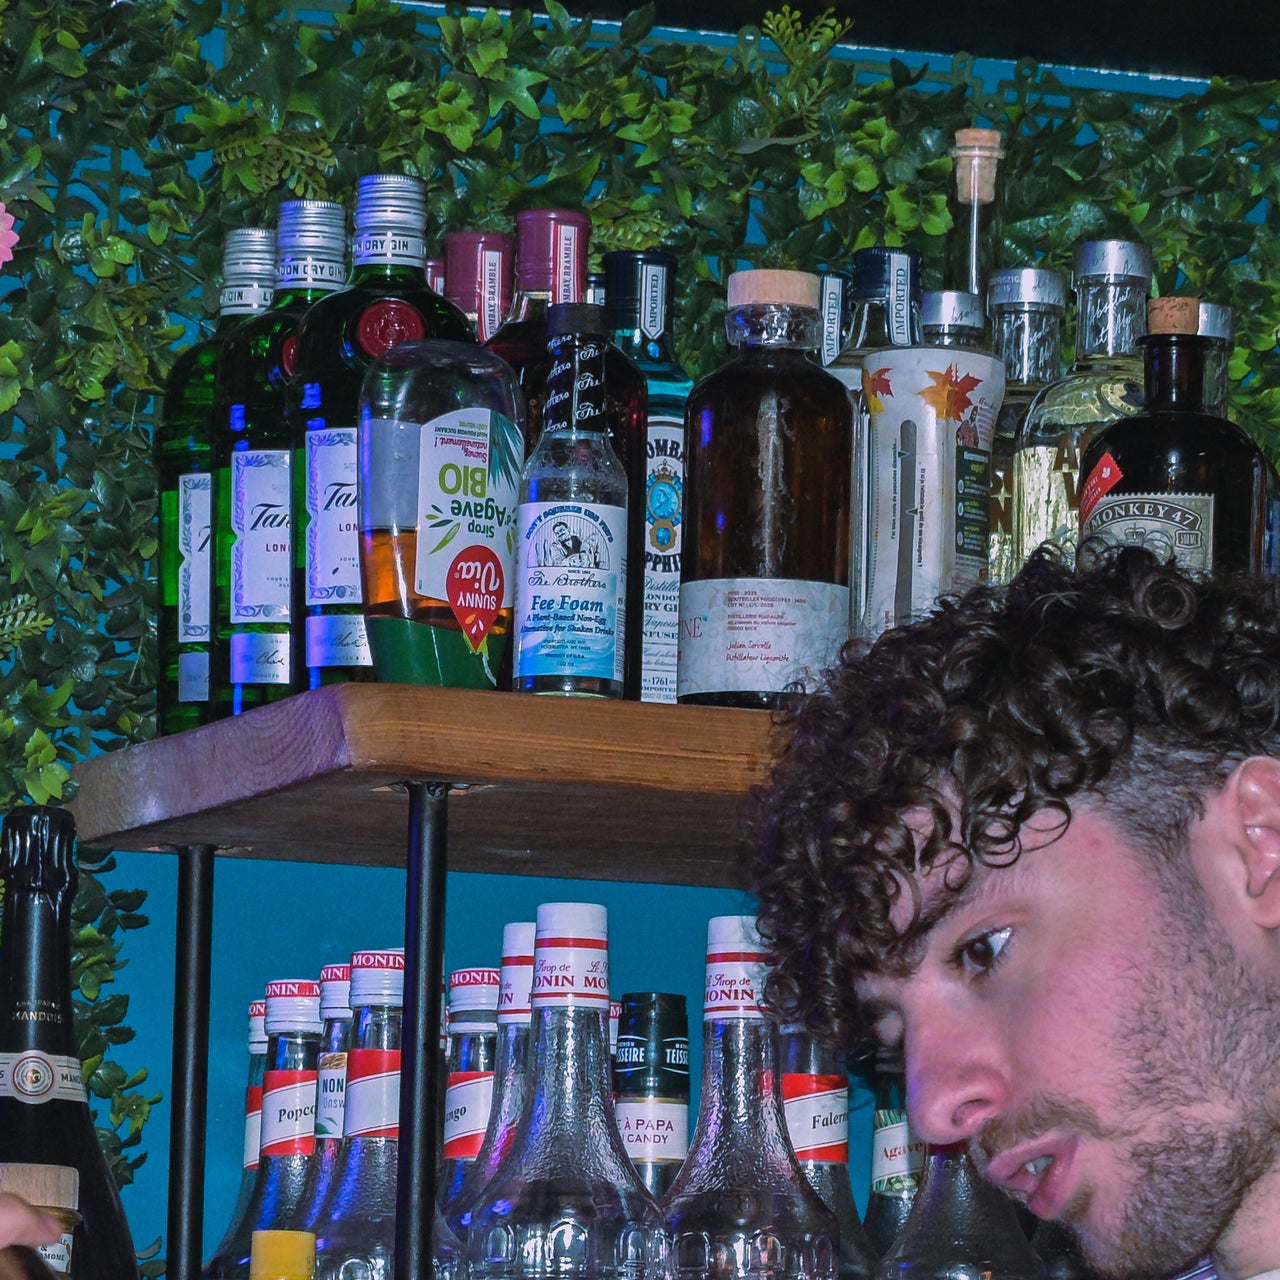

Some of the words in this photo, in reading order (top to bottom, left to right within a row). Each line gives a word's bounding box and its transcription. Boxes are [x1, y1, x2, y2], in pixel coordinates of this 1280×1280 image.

[366, 239, 385, 251] DRY
[390, 240, 409, 252] GIN
[563, 236, 572, 271] BRAMBLE
[328, 264, 344, 277] GIN
[489, 262, 497, 297] BRAMBLE
[229, 291, 244, 301] GIN
[649, 274, 658, 328] IMPORTED
[895, 268, 905, 335] IMPORTED
[827, 291, 837, 358] IMPORTED
[439, 463, 487, 498] BIO
[1090, 503, 1171, 531] MONKEY
[1173, 513, 1195, 526] 47
[468, 520, 495, 539] Sirop
[457, 562, 500, 594] Via
[552, 573, 607, 589] Brothers
[457, 591, 497, 610] SUNNY
[531, 595, 555, 611] Fee
[559, 595, 603, 613] Foam
[533, 614, 576, 622] Plant-Based
[577, 615, 607, 626] Non-Egg
[553, 624, 566, 636] for
[567, 625, 593, 633] Shaken
[651, 676, 668, 686] 1761
[559, 962, 570, 972] de
[715, 973, 736, 987] Sirop
[738, 977, 751, 986] de
[12, 1011, 63, 1024] MANDOIS
[623, 1117, 631, 1130] À
[636, 1118, 674, 1132] PAPA
[627, 1133, 668, 1145] CANDY
